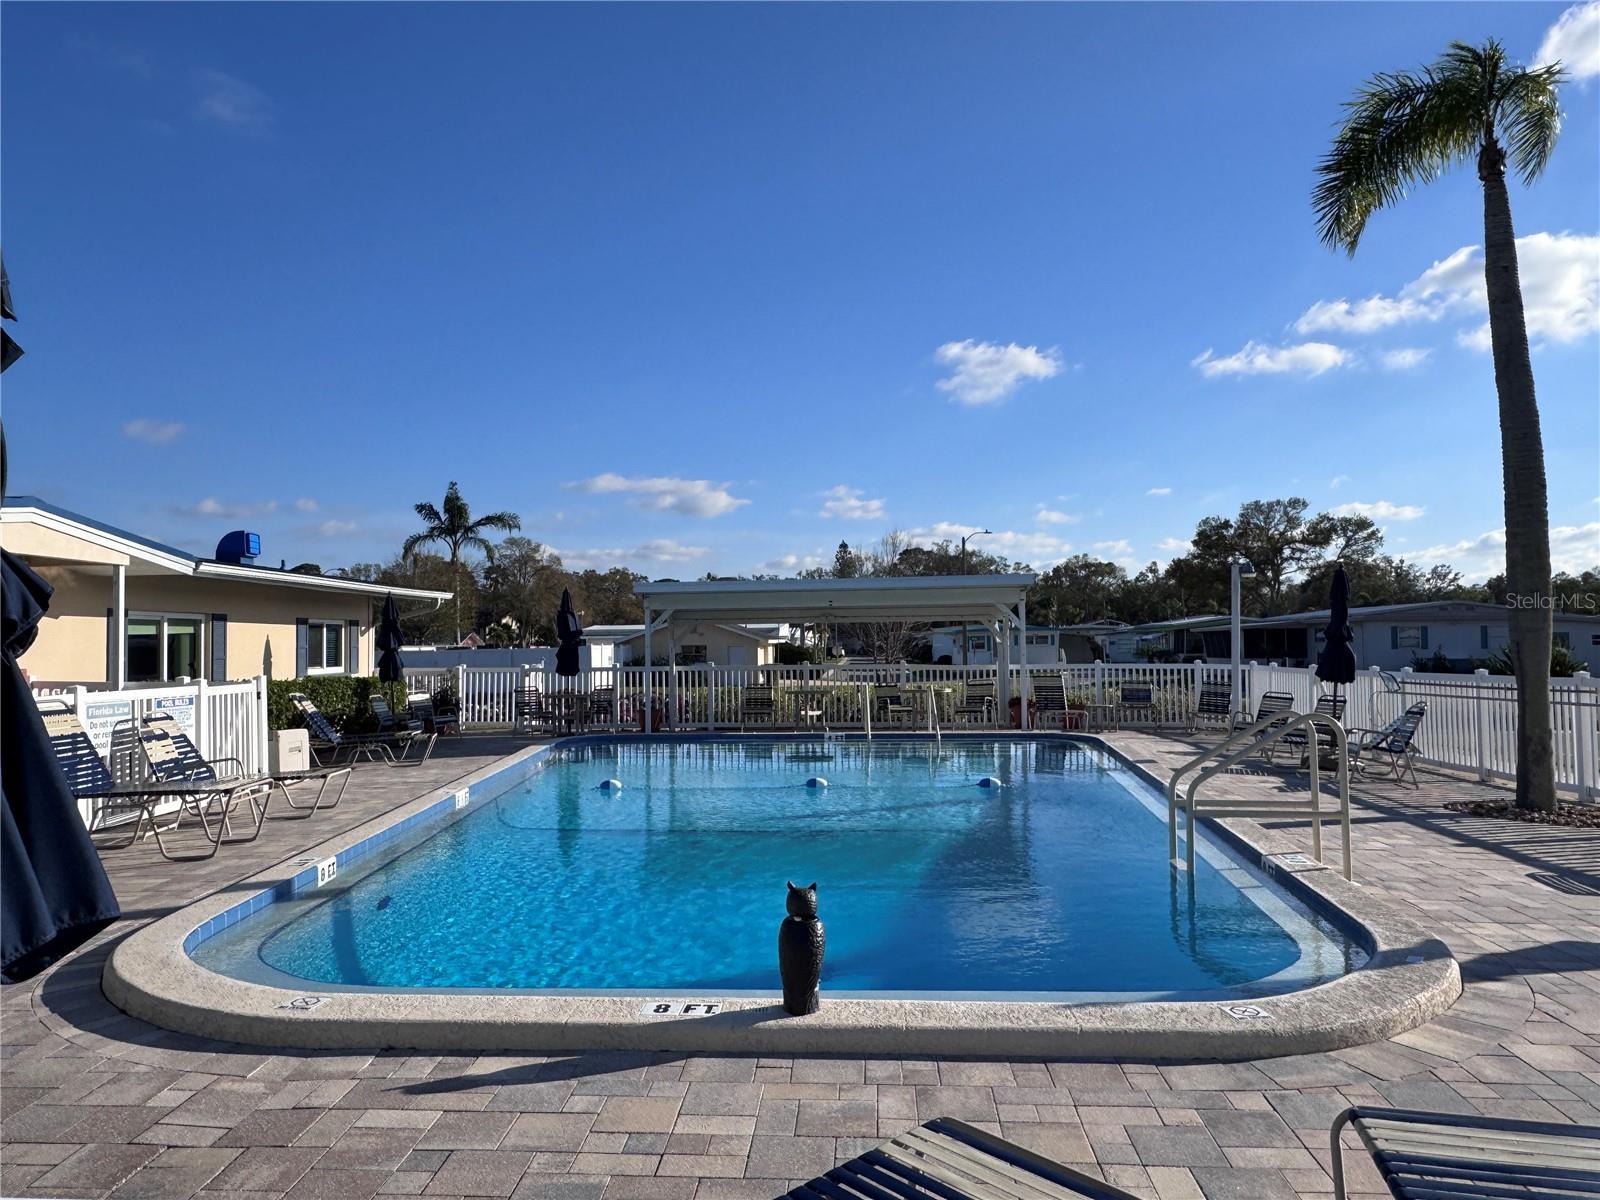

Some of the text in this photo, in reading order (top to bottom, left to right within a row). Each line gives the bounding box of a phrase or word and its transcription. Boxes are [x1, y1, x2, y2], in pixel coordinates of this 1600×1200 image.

[88, 705, 129, 717] Florida Law
[90, 721, 99, 729] Do
[99, 720, 109, 729] not
[93, 732, 101, 740] or
[653, 1004, 671, 1014] 8
